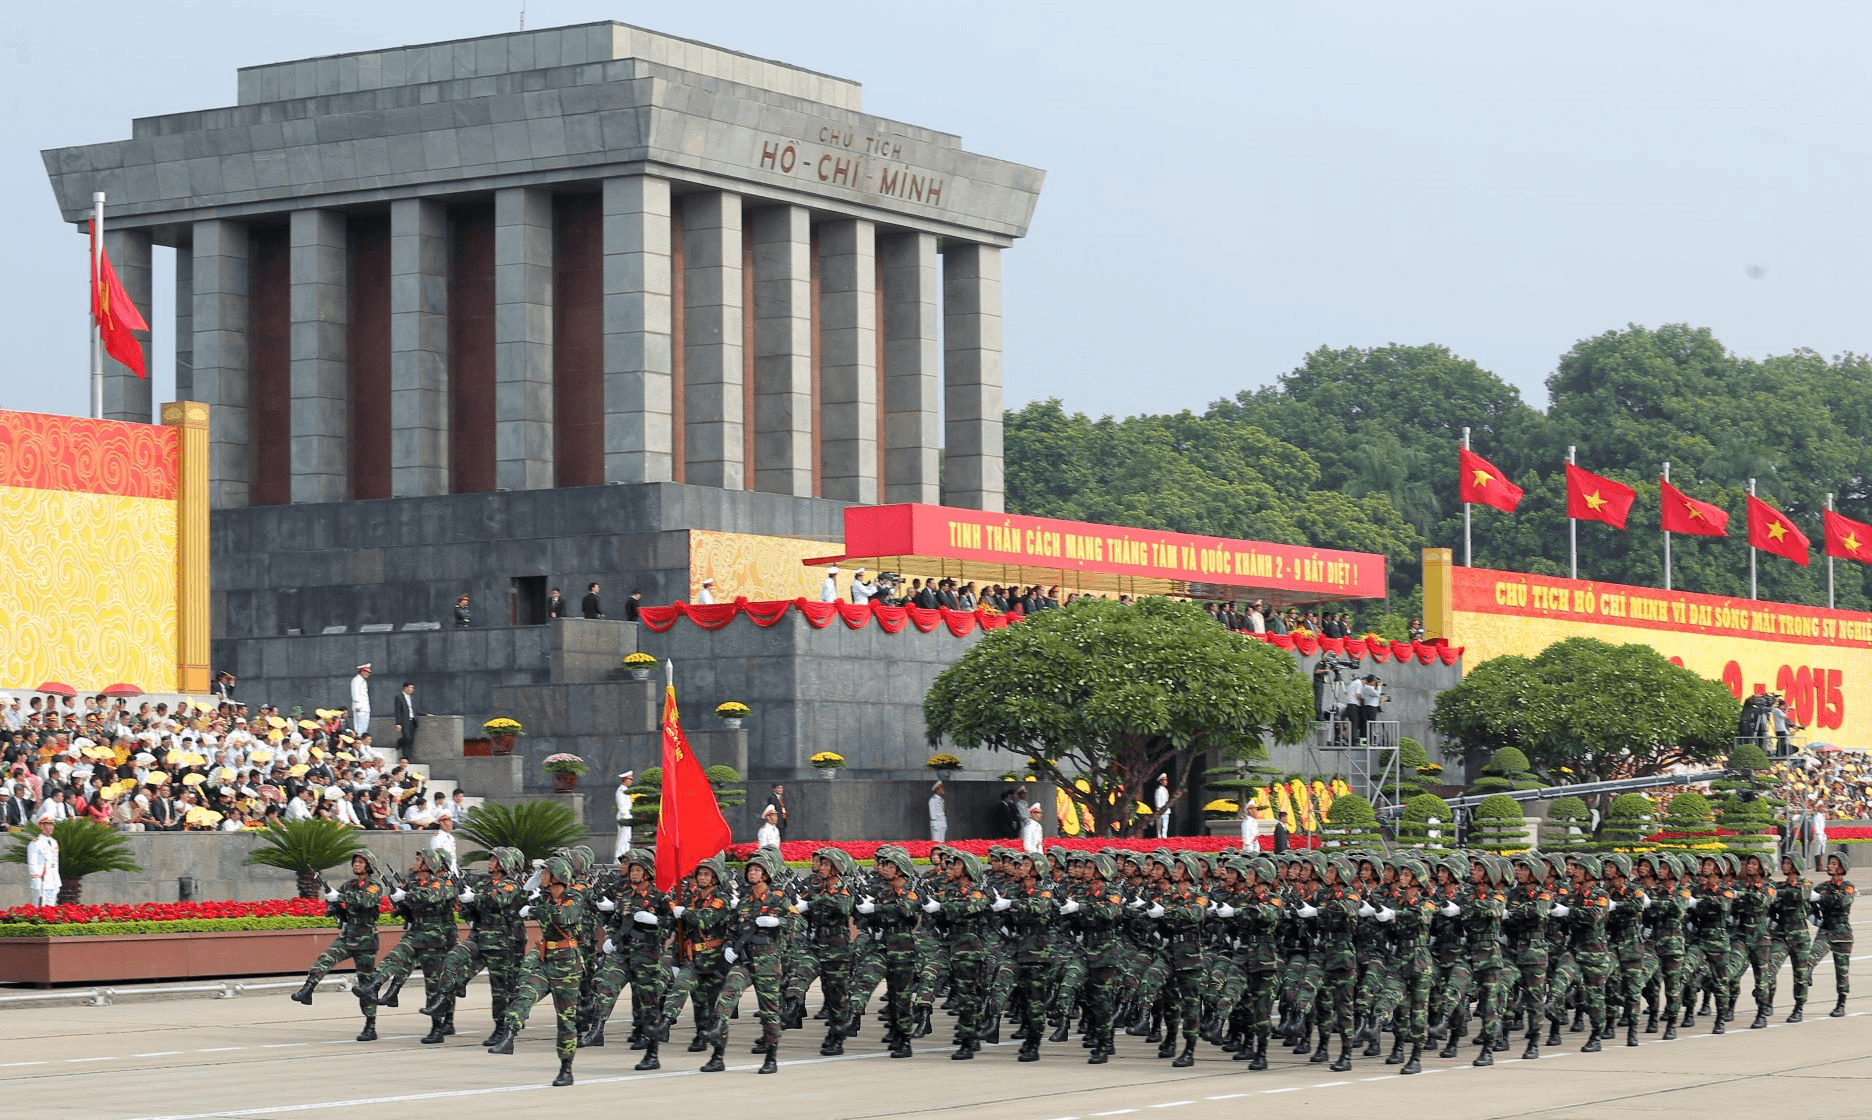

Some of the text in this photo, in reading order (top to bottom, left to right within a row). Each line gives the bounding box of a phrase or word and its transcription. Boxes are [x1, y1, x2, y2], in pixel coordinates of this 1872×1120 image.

[818, 154, 863, 187] CHÍ
[948, 521, 981, 549] TINH
[986, 518, 1021, 553] THẦN
[1026, 526, 1061, 557] CÁCH
[1065, 534, 1103, 565] MẠNG
[1107, 535, 1148, 566] THÁNG
[1152, 539, 1178, 568] TÁM
[1182, 542, 1196, 570] VÀ
[1201, 542, 1231, 574] QUỐC
[1235, 549, 1272, 577] KHÁNH
[1304, 552, 1324, 583] BẤT
[1328, 558, 1350, 589] DIỆT
[1495, 578, 1527, 608] CHỦ
[1532, 585, 1570, 614] TỊCH
[1574, 582, 1595, 614] HỒ
[1600, 590, 1626, 618] CHÍ
[1630, 596, 1668, 622] MINH
[1715, 600, 1748, 630] SỐNG
[1778, 614, 1819, 637] TRONG
[1776, 664, 1844, 730] 2015
